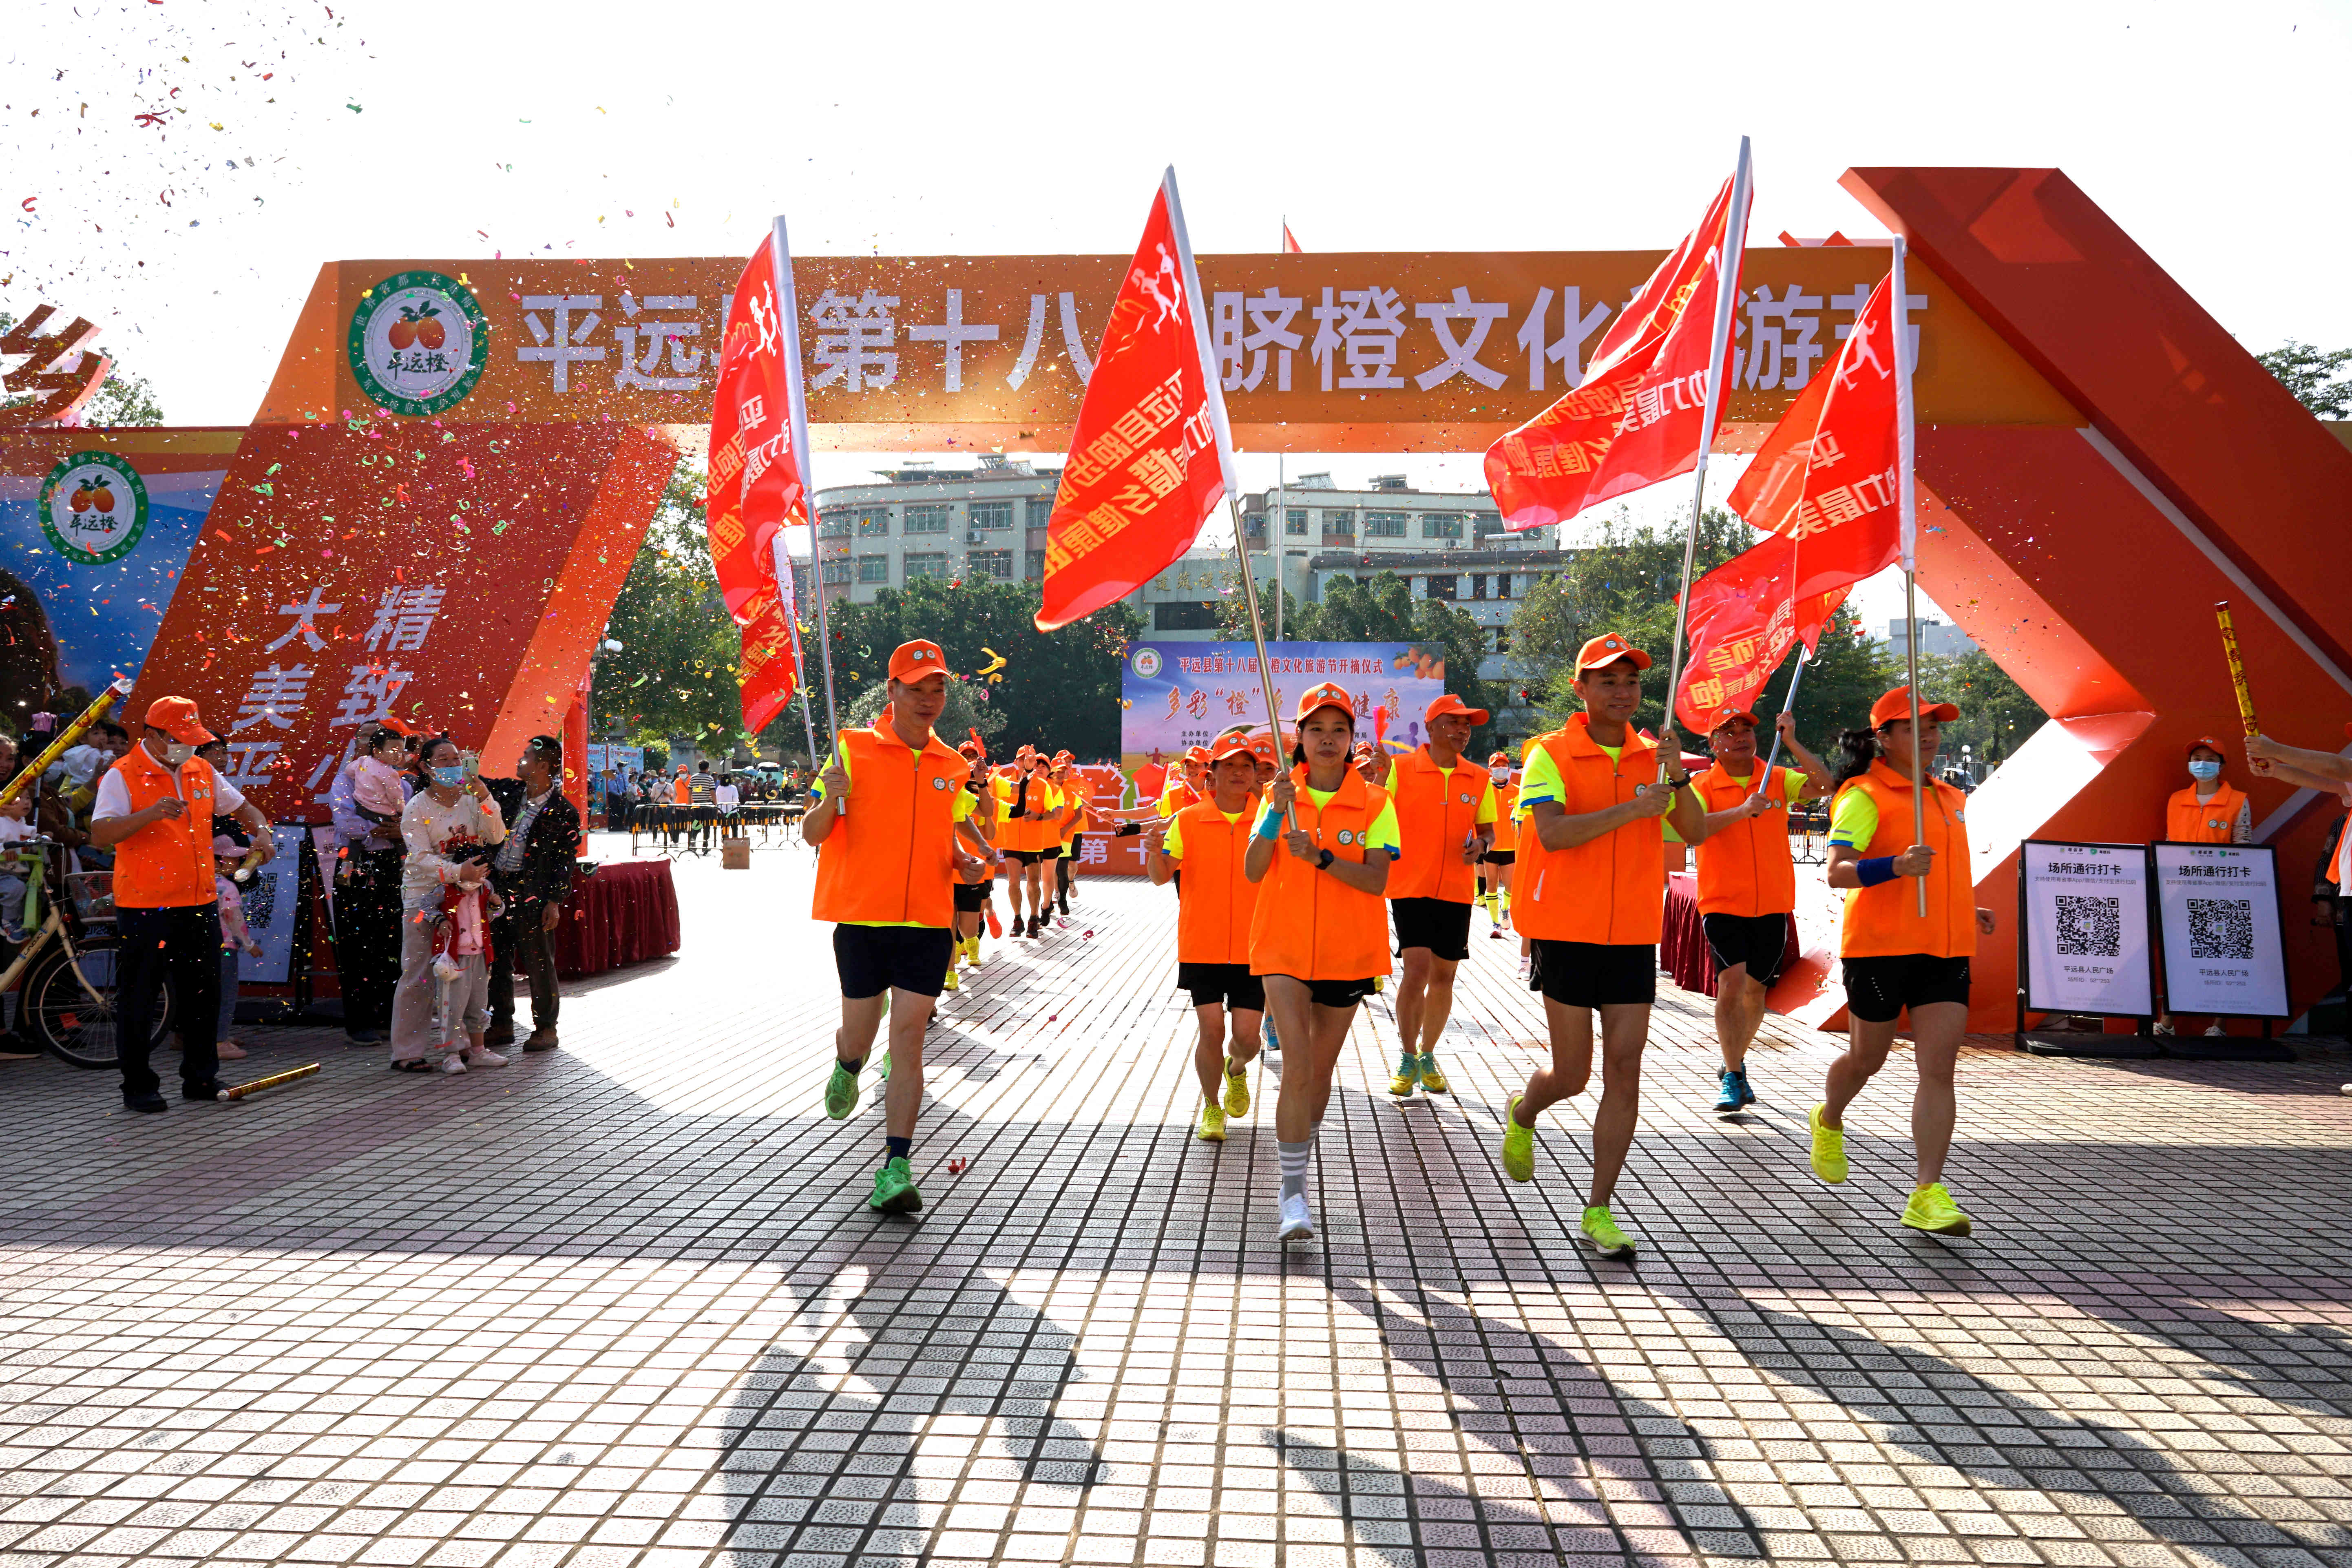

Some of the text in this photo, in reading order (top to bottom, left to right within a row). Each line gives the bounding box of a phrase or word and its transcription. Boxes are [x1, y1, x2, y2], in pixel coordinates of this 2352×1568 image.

[1179, 657, 1383, 673] 平远县第十八届橙文化旅游节开摘仪式
[2048, 862, 2122, 876] 场所通行打卡
[2178, 865, 2251, 878] 场所通行打卡
[2064, 965, 2114, 975] 平远县人民广场
[2199, 969, 2249, 977] 平远县人民广场
